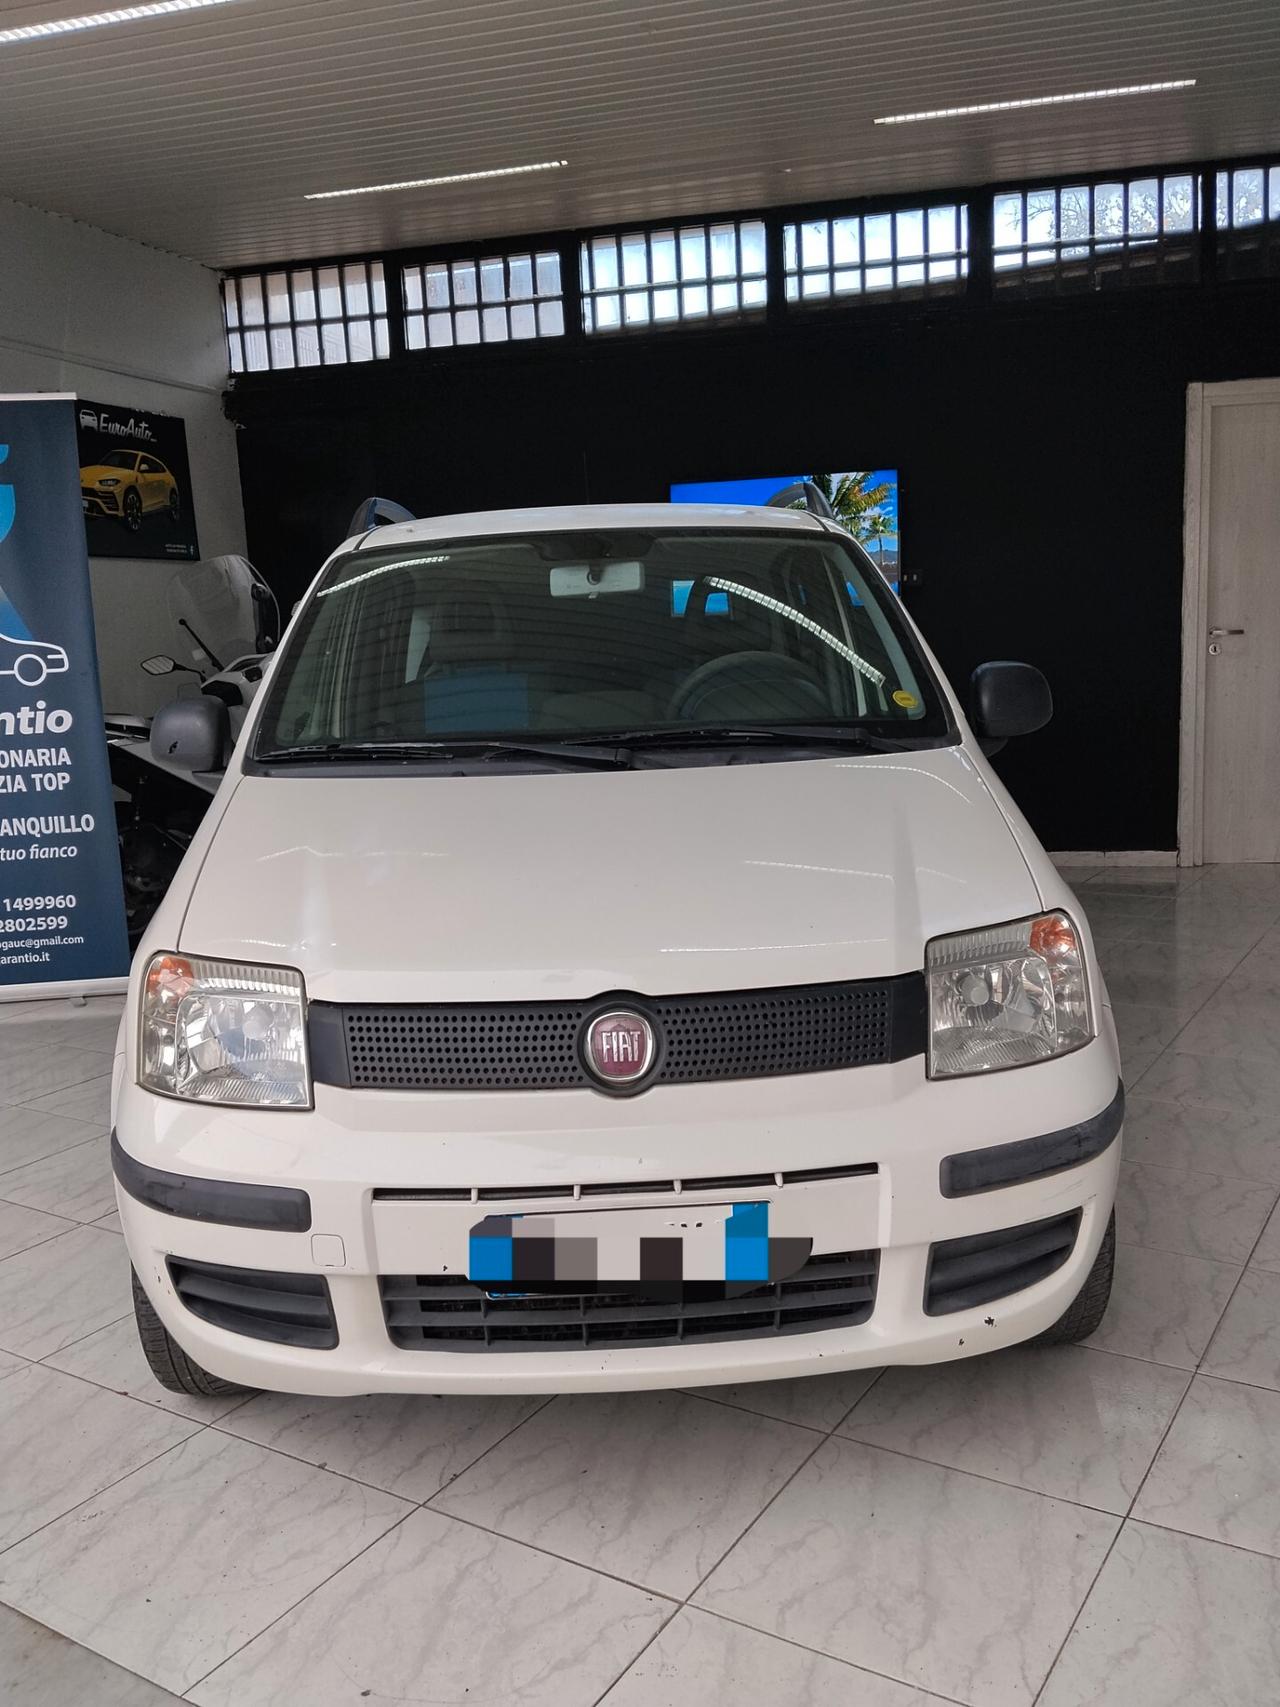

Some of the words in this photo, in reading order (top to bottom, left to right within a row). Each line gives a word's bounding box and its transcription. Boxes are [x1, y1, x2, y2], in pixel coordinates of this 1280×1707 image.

[100, 413, 153, 441] EuroAuto
[0, 747, 72, 769] ONARIA
[31, 772, 71, 791] TOP
[0, 814, 95, 837] ANQUILLO
[0, 847, 26, 861] tuo
[29, 844, 78, 860] fianco
[3, 894, 77, 911] 1499960
[0, 915, 68, 932] 2802599
[601, 1031, 641, 1063] FIAT
